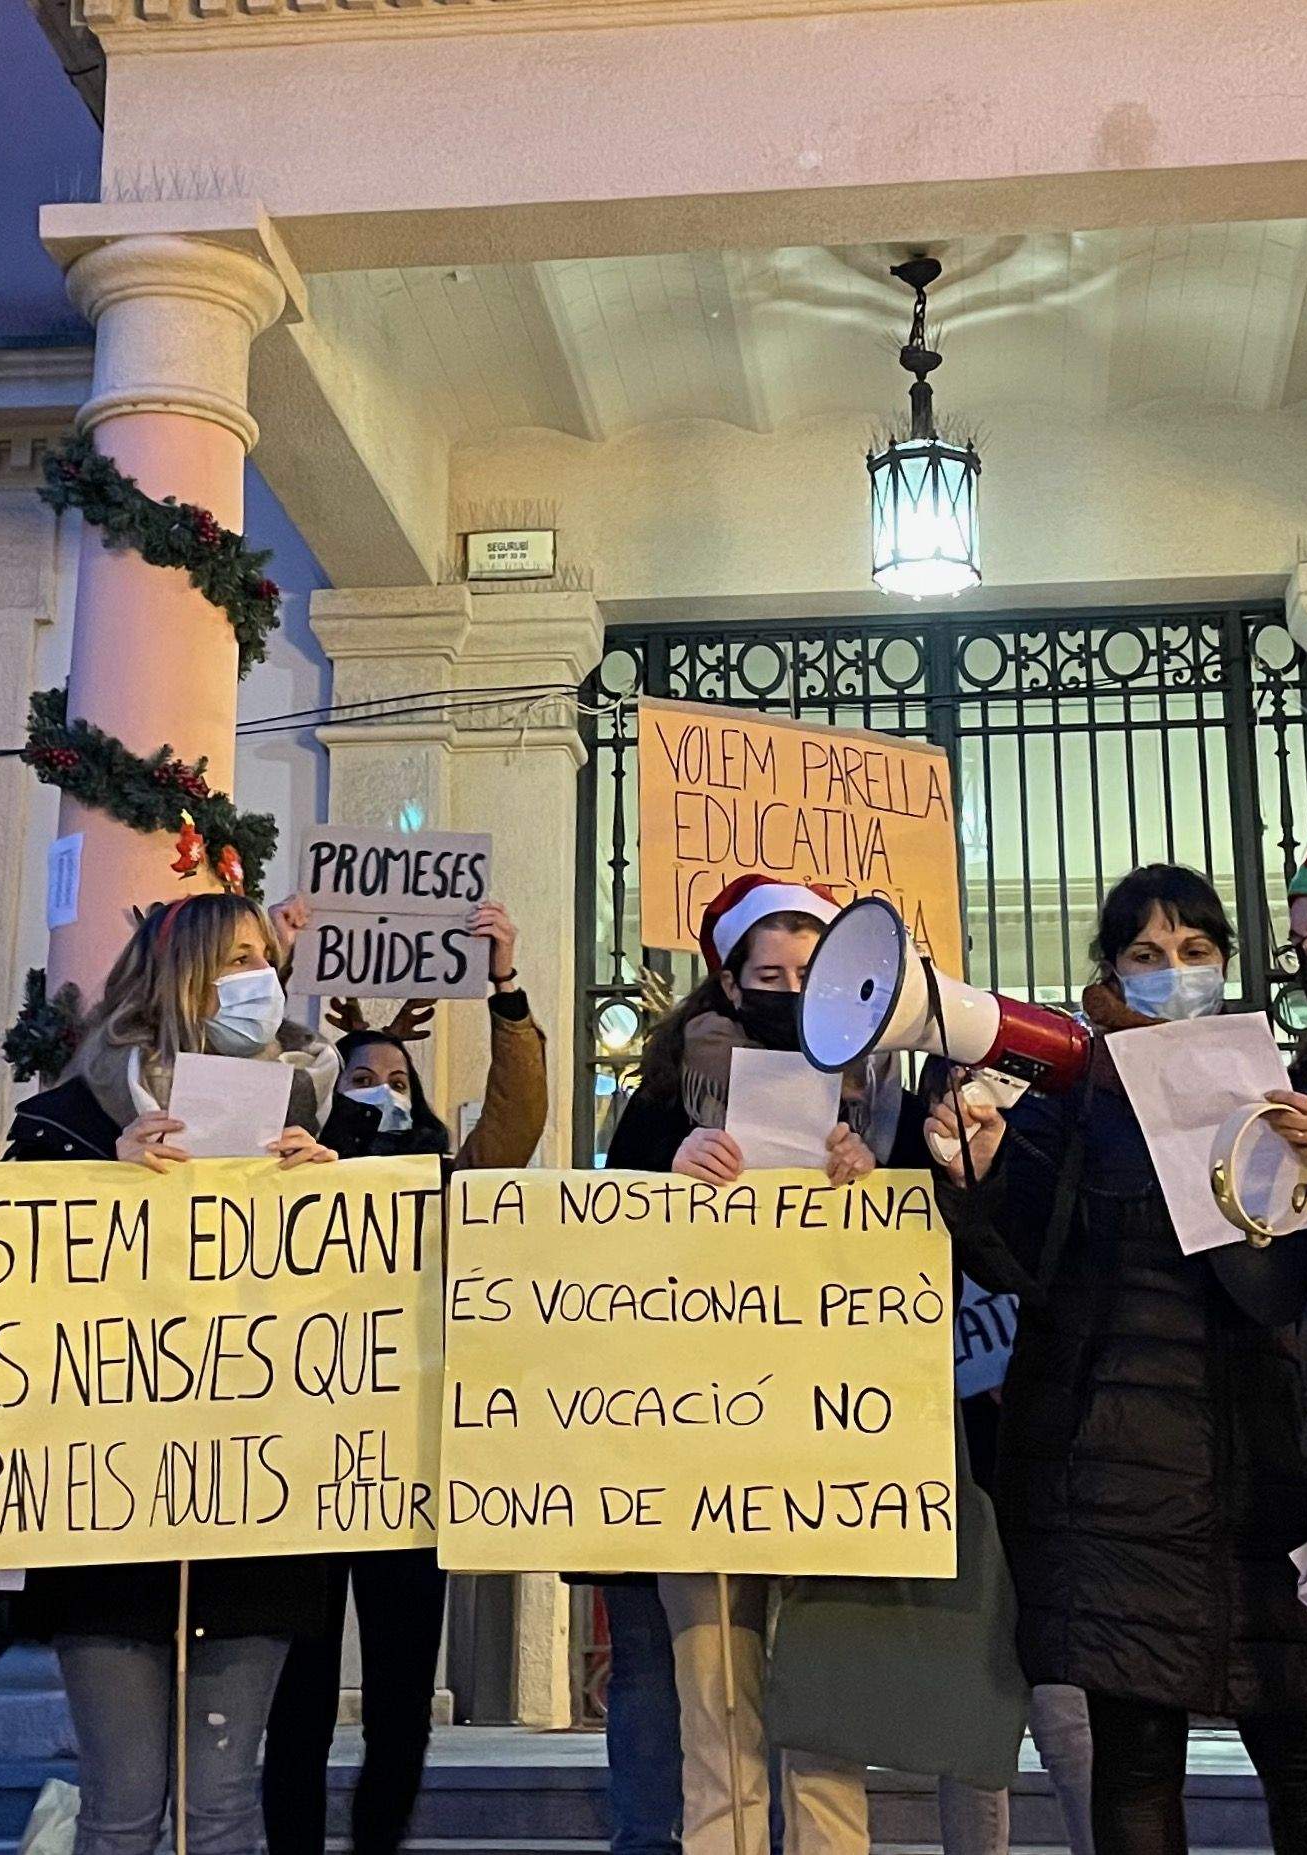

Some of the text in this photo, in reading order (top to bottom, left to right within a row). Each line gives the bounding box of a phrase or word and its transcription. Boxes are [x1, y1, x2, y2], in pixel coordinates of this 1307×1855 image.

[655, 721, 949, 822] VOLEM PARELLA
[675, 790, 893, 885] EDUCATIVA
[309, 841, 486, 902] PROMESES
[316, 916, 471, 985] BUIDES
[189, 1189, 441, 1281] EDUCANT
[461, 1179, 932, 1232] LA NOSTRA FEINA
[450, 1266, 944, 1328] ÉS VOCACIONAL PERÒ
[51, 1314, 277, 1407] NENS/ES
[294, 1308, 404, 1404] QUE
[453, 1373, 892, 1435] LA VOCACIÓ NO
[67, 1441, 135, 1531] ELS
[149, 1434, 289, 1528] ADULTS
[334, 1429, 401, 1482] DEL
[317, 1480, 437, 1532] FUTUR
[449, 1480, 952, 1533] DONA DE MENJAR
